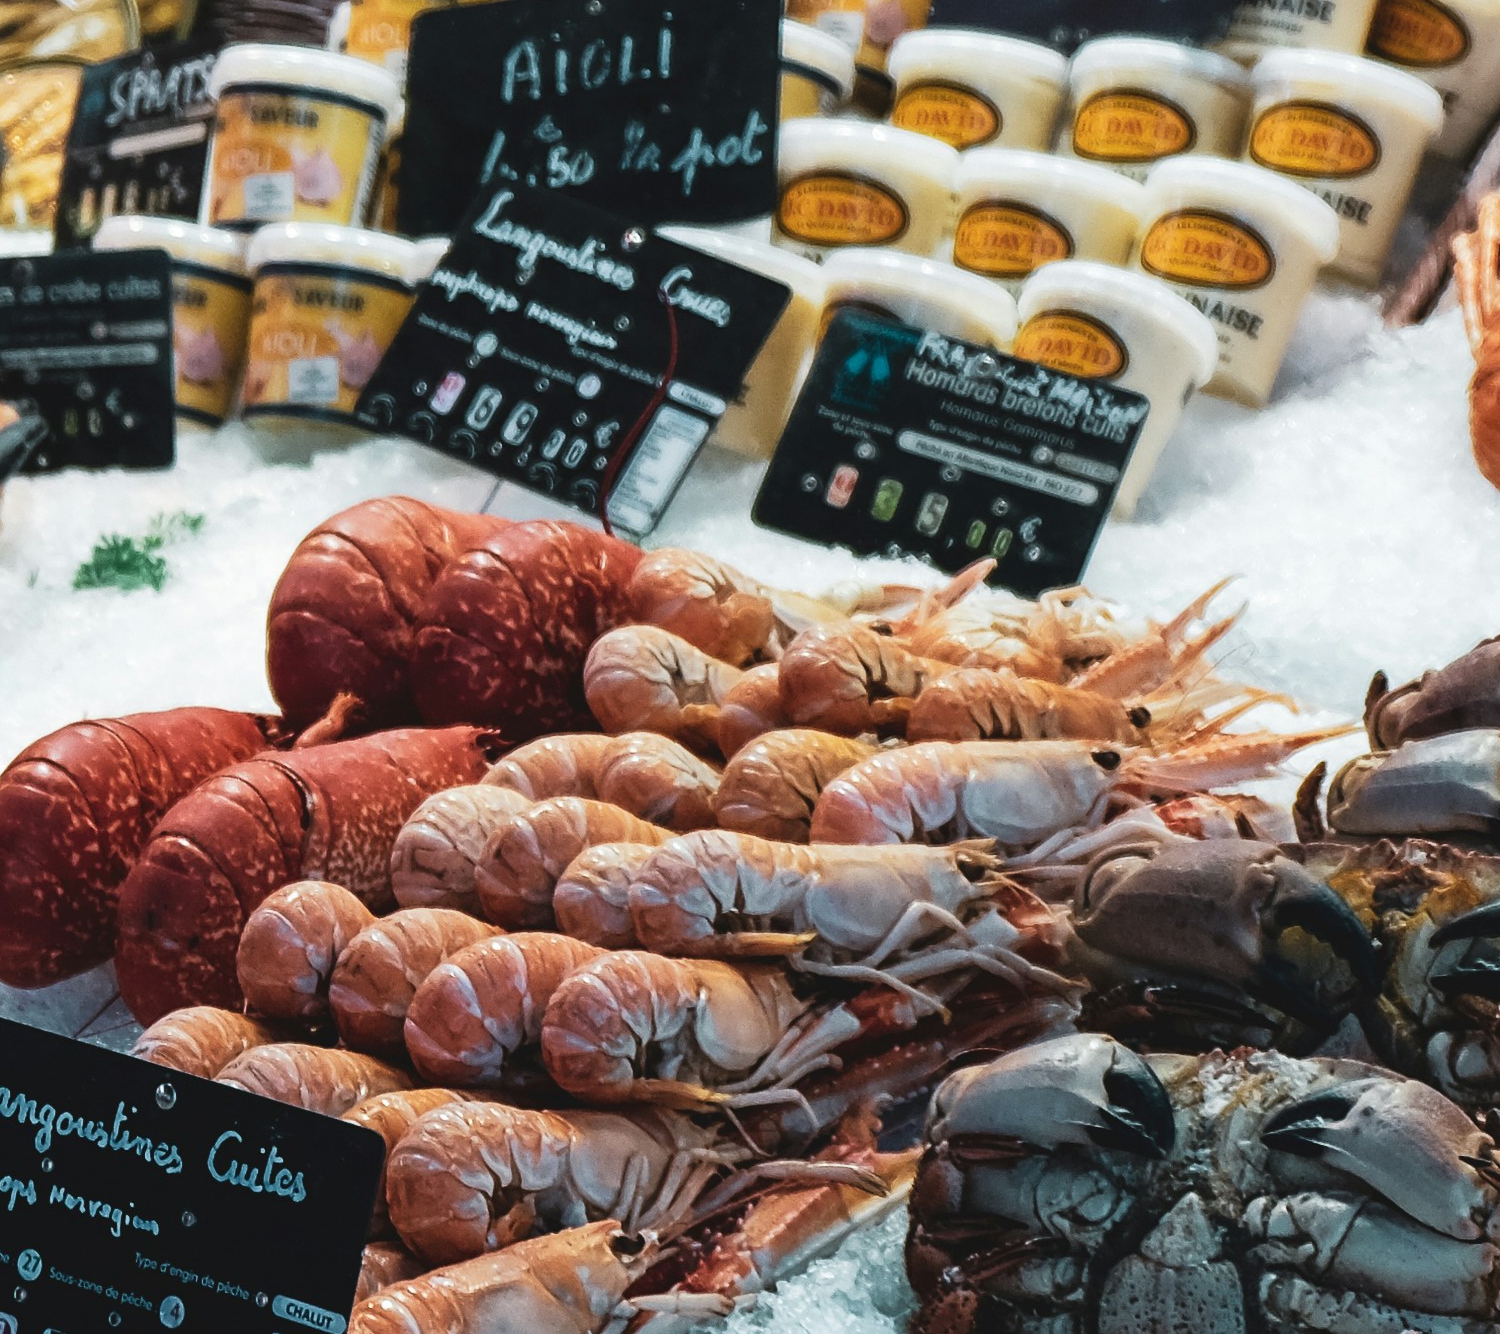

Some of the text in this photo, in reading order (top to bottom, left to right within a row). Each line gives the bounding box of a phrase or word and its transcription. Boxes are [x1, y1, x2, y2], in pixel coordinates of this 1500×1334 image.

[206, 1129, 307, 1202] Cuites
[20, 1252, 41, 1273] 27
[135, 1251, 250, 1300] Type d'engin de pêche
[48, 1266, 104, 1295] Sous-zone
[105, 1285, 120, 1301] de
[120, 1291, 154, 1311] pêche
[285, 1301, 334, 1330] CHALUT
